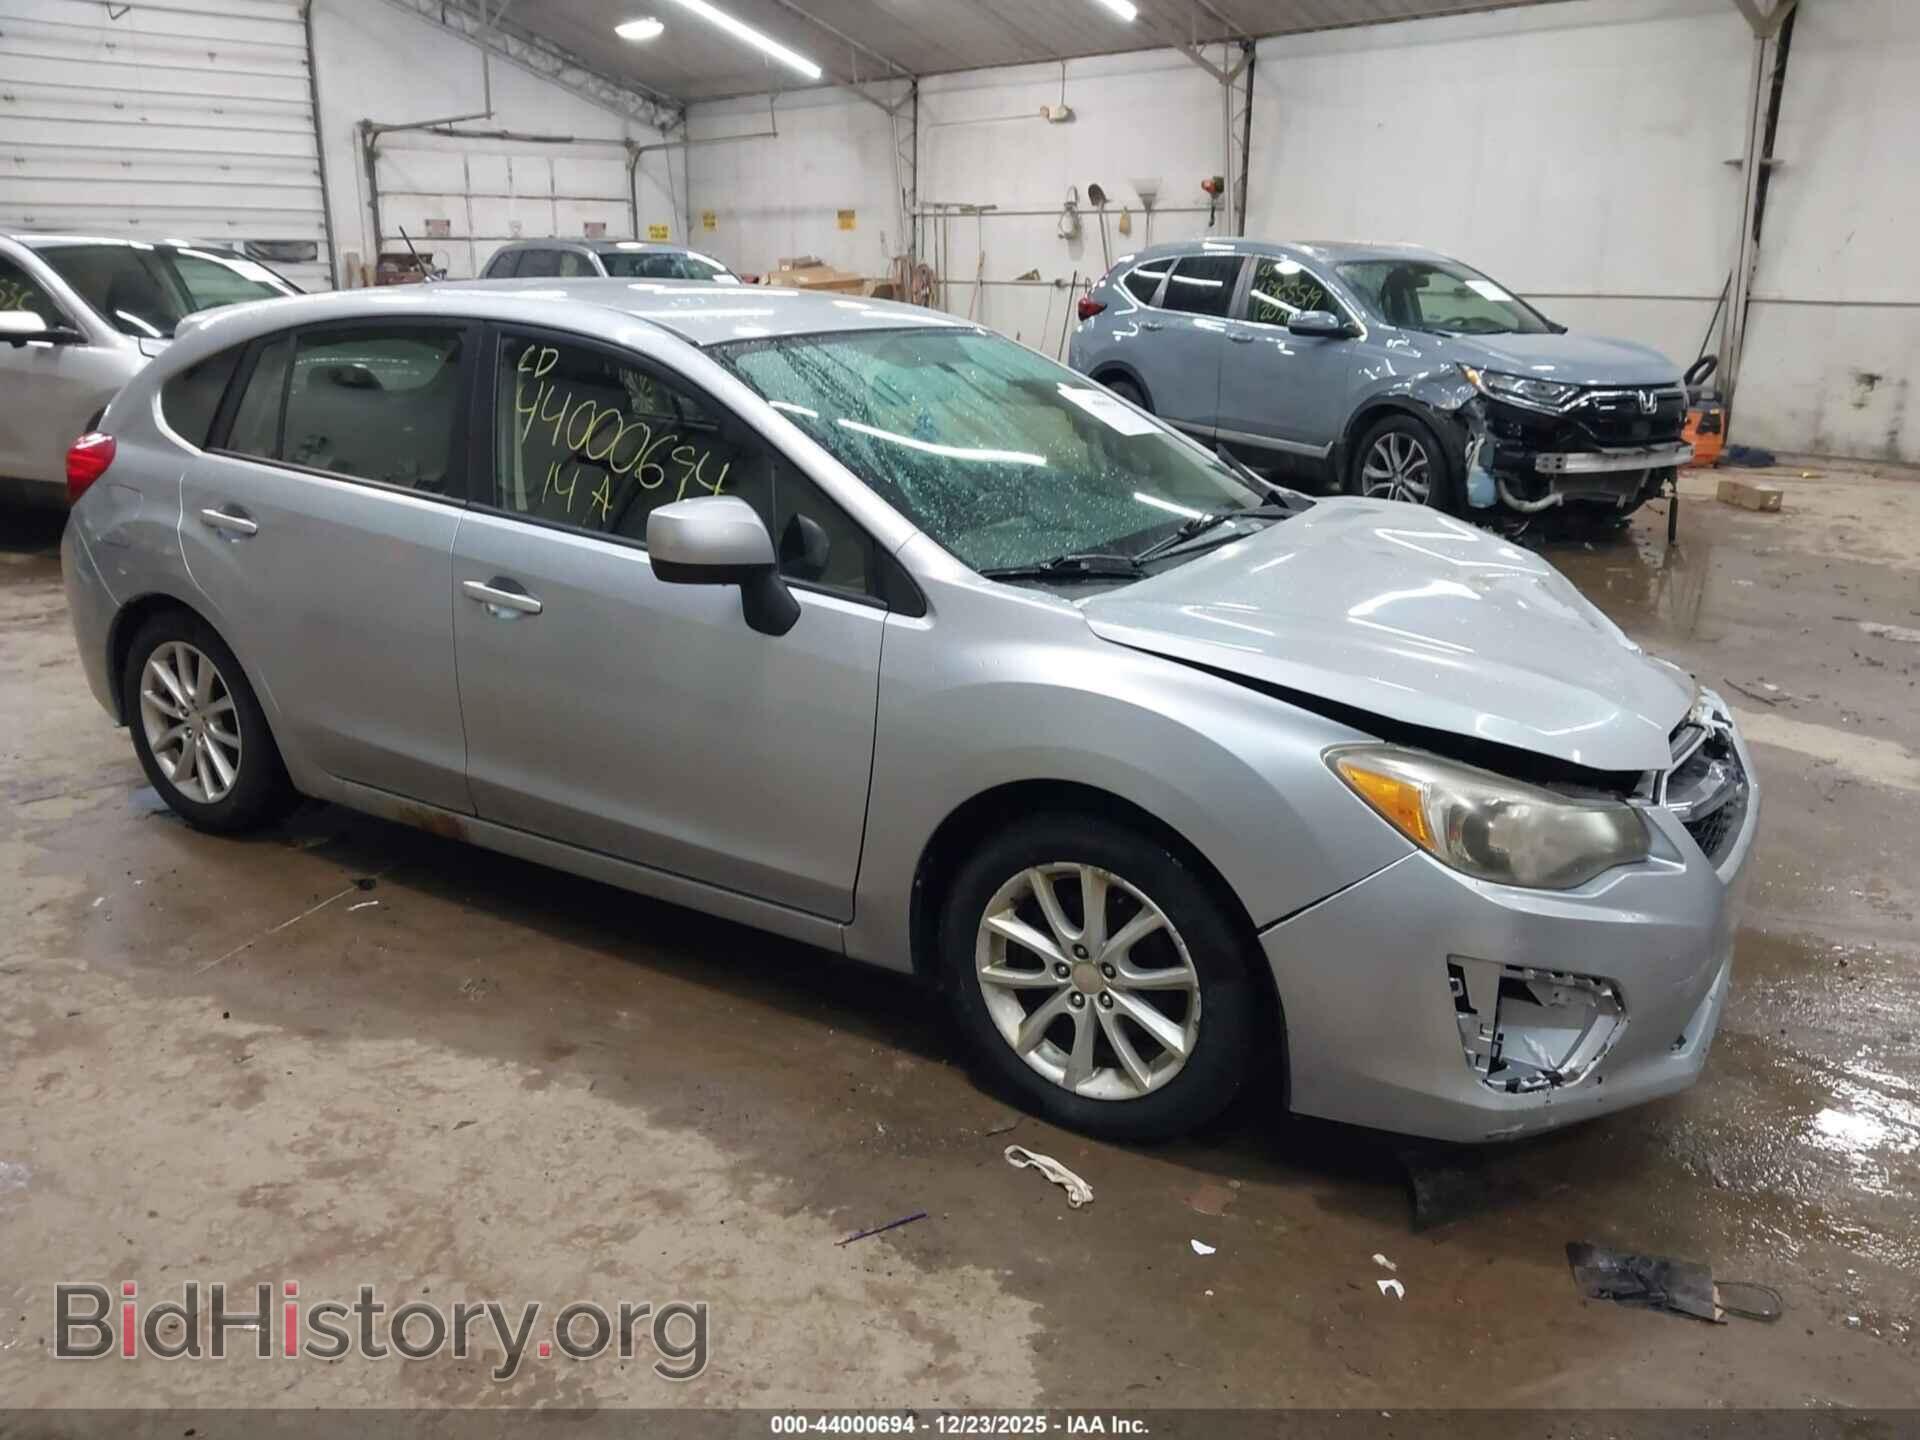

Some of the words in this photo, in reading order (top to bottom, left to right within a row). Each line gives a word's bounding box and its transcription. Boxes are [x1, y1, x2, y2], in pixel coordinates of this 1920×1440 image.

[516, 380, 730, 503] 44000694
[542, 460, 580, 513] 14
[591, 474, 613, 523] A
